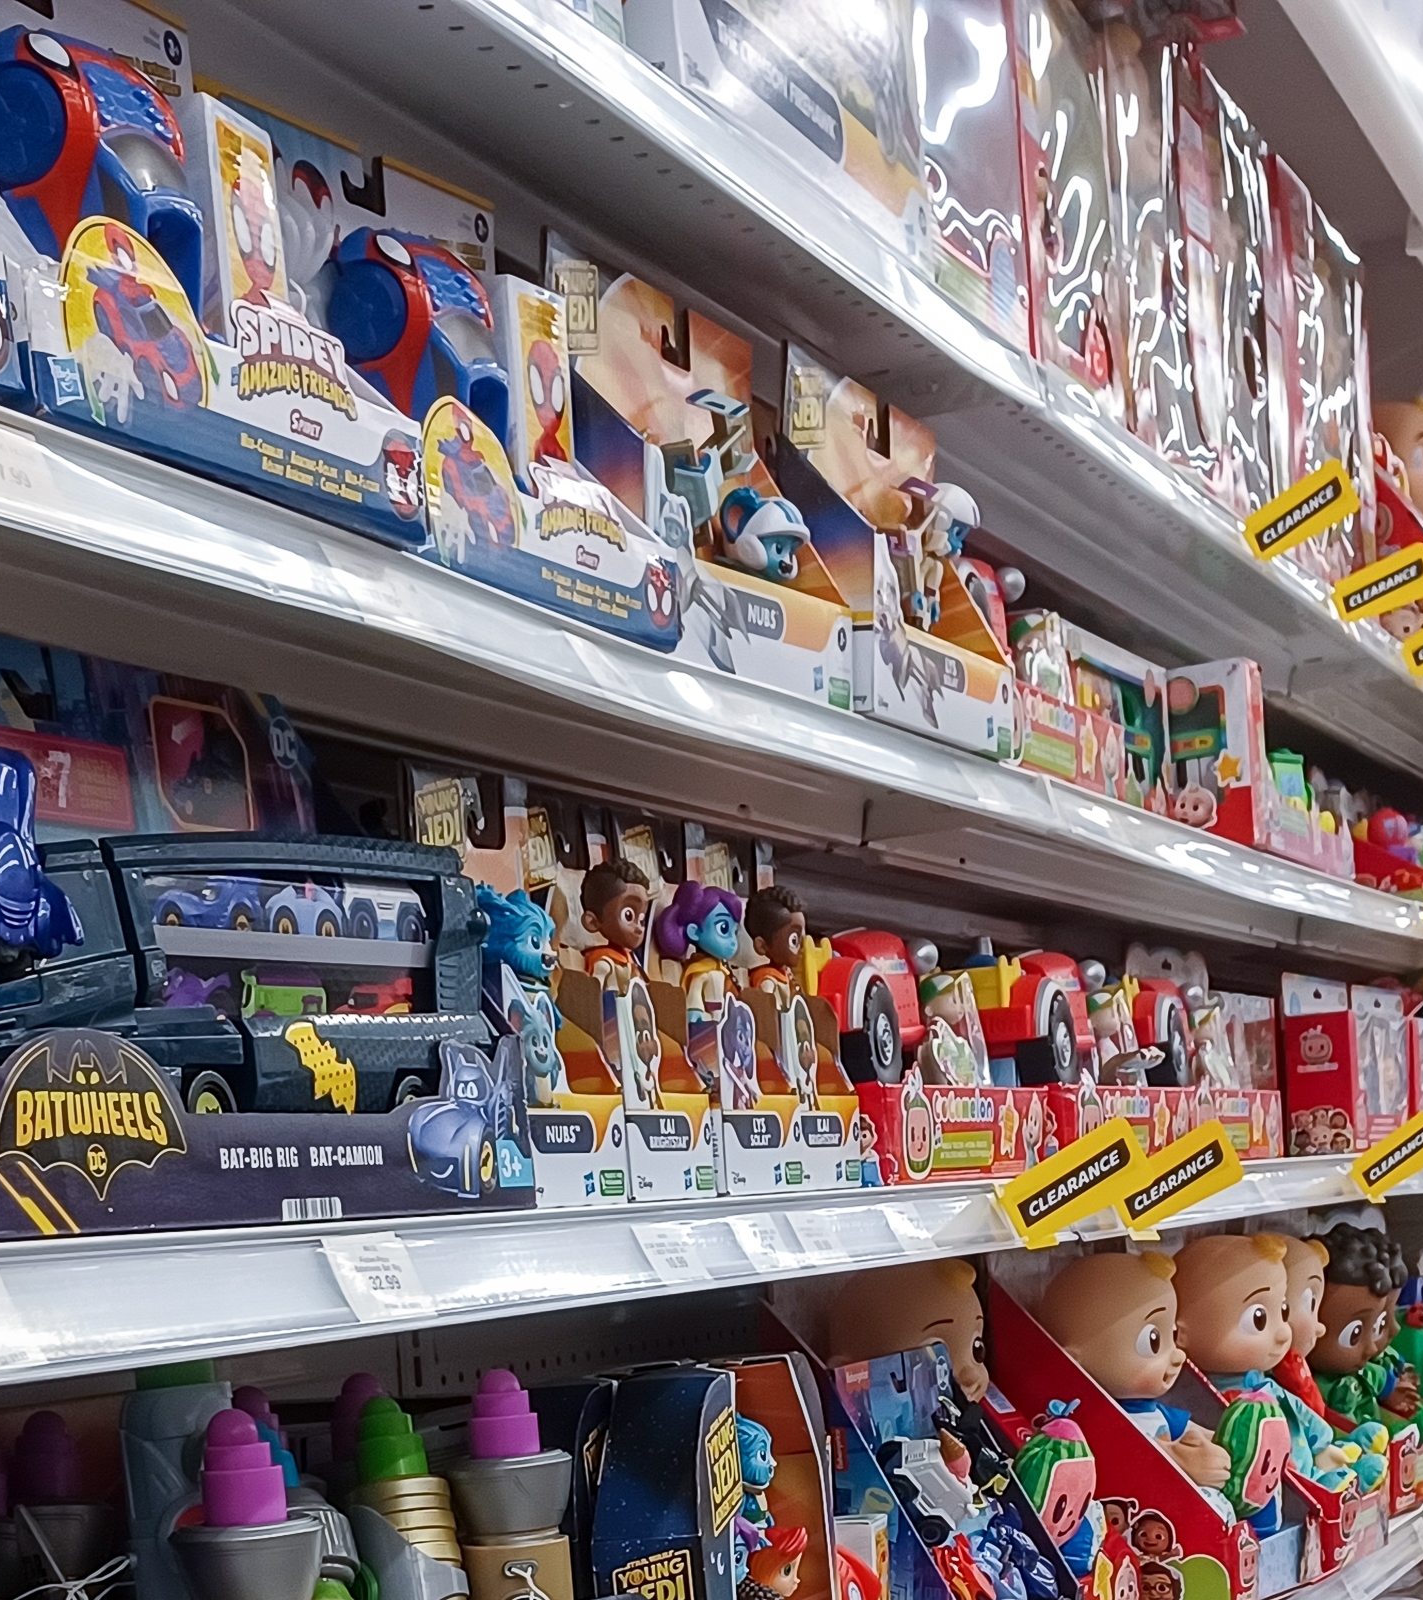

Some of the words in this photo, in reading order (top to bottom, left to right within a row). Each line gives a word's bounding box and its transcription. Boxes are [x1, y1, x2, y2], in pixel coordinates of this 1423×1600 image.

[237, 306, 347, 388] SPIDEY
[239, 361, 300, 396] AMAZING
[302, 365, 358, 420] FRIENDS
[1259, 480, 1338, 546] CLEARANCE
[1346, 559, 1423, 611] CLEARANCE
[15, 1090, 168, 1146] BATWHEELS
[659, 1118, 676, 1134] KAI
[220, 1145, 273, 1169] BAT-BIG
[277, 1146, 299, 1168] RIG
[310, 1145, 383, 1168] BAT-CAMION
[500, 1153, 523, 1178] 3+
[1027, 1147, 1123, 1220] CLEARANCE
[1133, 1148, 1218, 1212] CLEARANCE
[368, 1274, 401, 1291] 32.99
[618, 1558, 685, 1590] YOUNG
